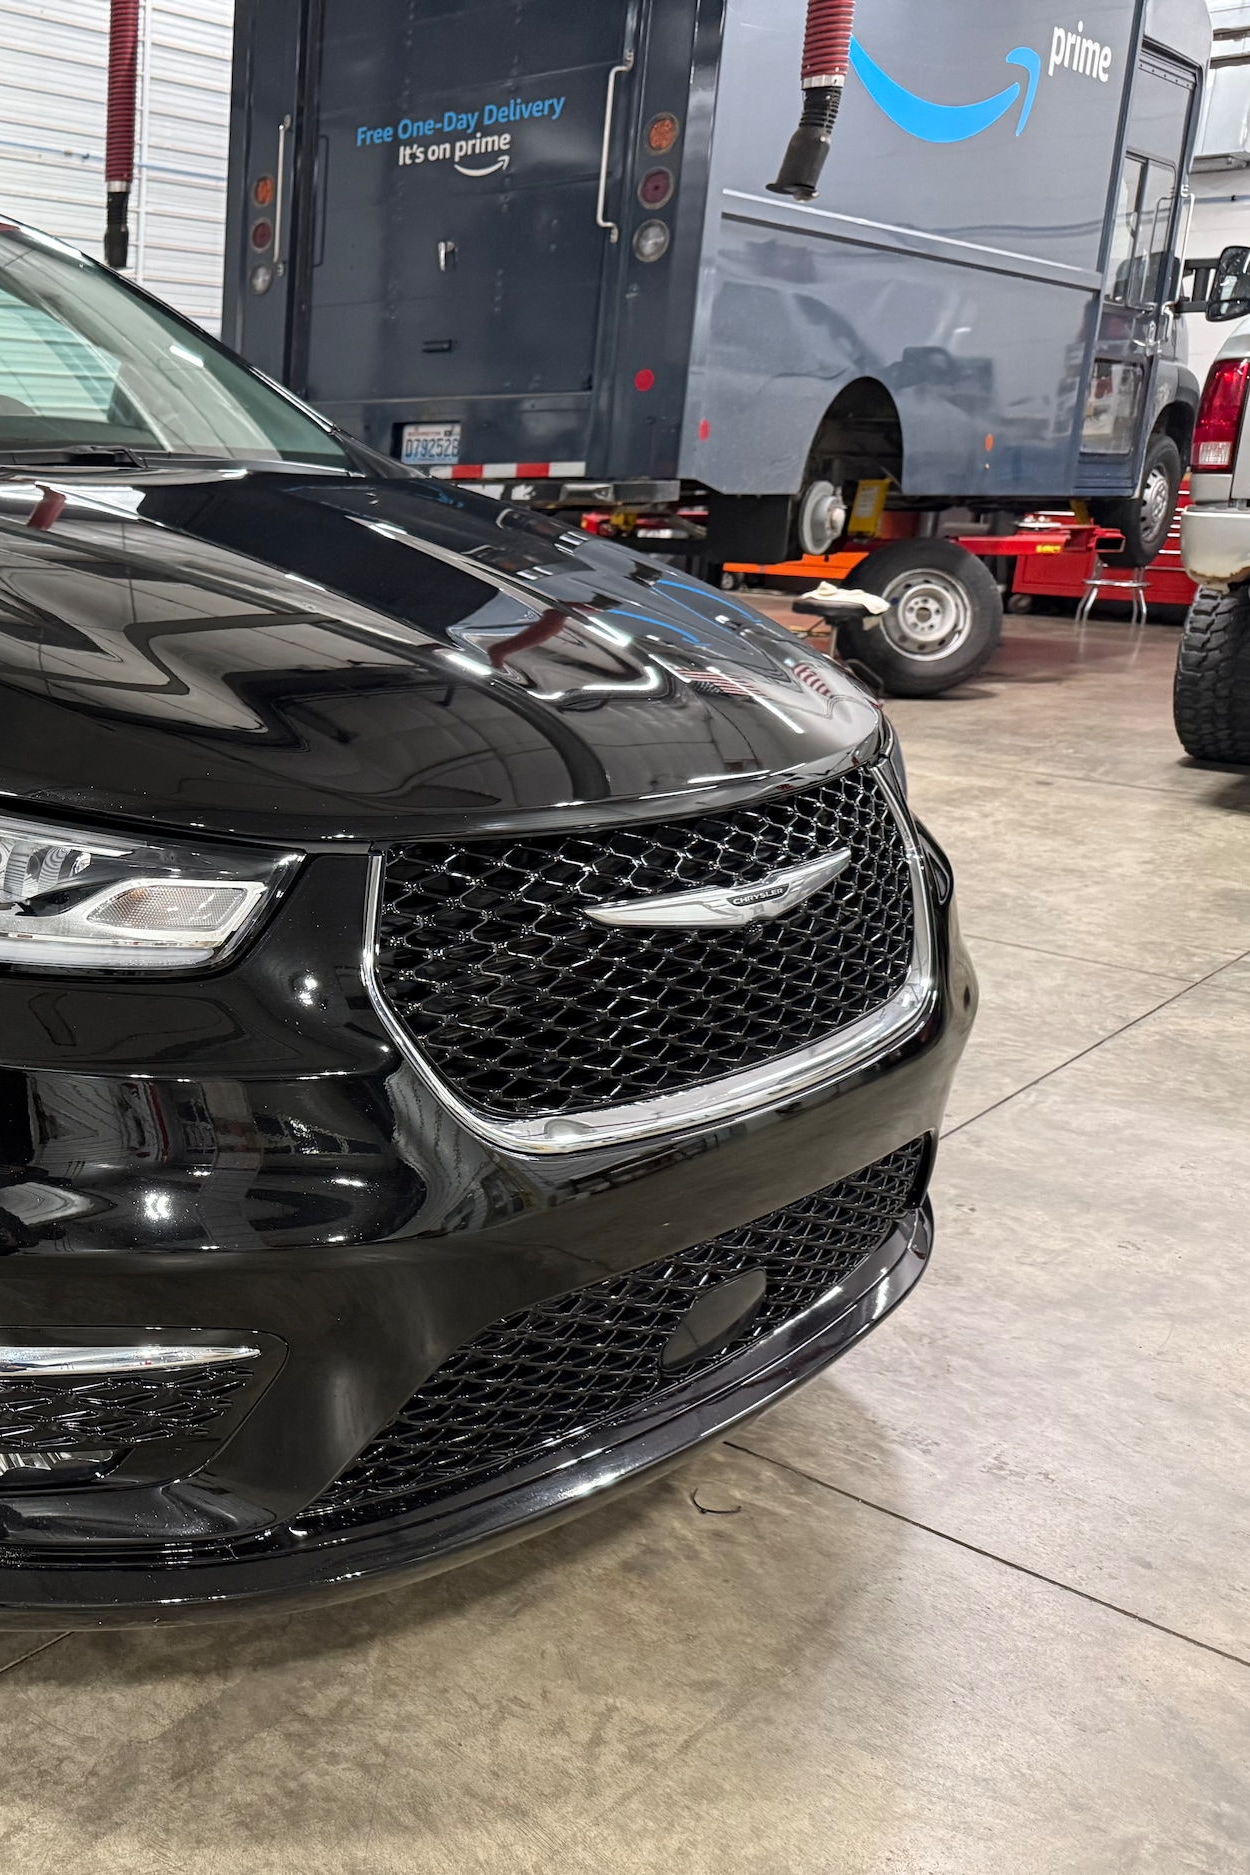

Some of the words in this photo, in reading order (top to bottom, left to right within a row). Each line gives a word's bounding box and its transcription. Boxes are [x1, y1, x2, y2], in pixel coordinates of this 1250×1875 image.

[1048, 20, 1112, 82] prime
[356, 126, 393, 147] Free
[397, 111, 479, 139] One-Day
[483, 97, 565, 125] Delivery
[398, 145, 425, 166] It's
[427, 142, 451, 161] on
[454, 131, 512, 162] prime
[733, 888, 783, 905] CHRYSLER
